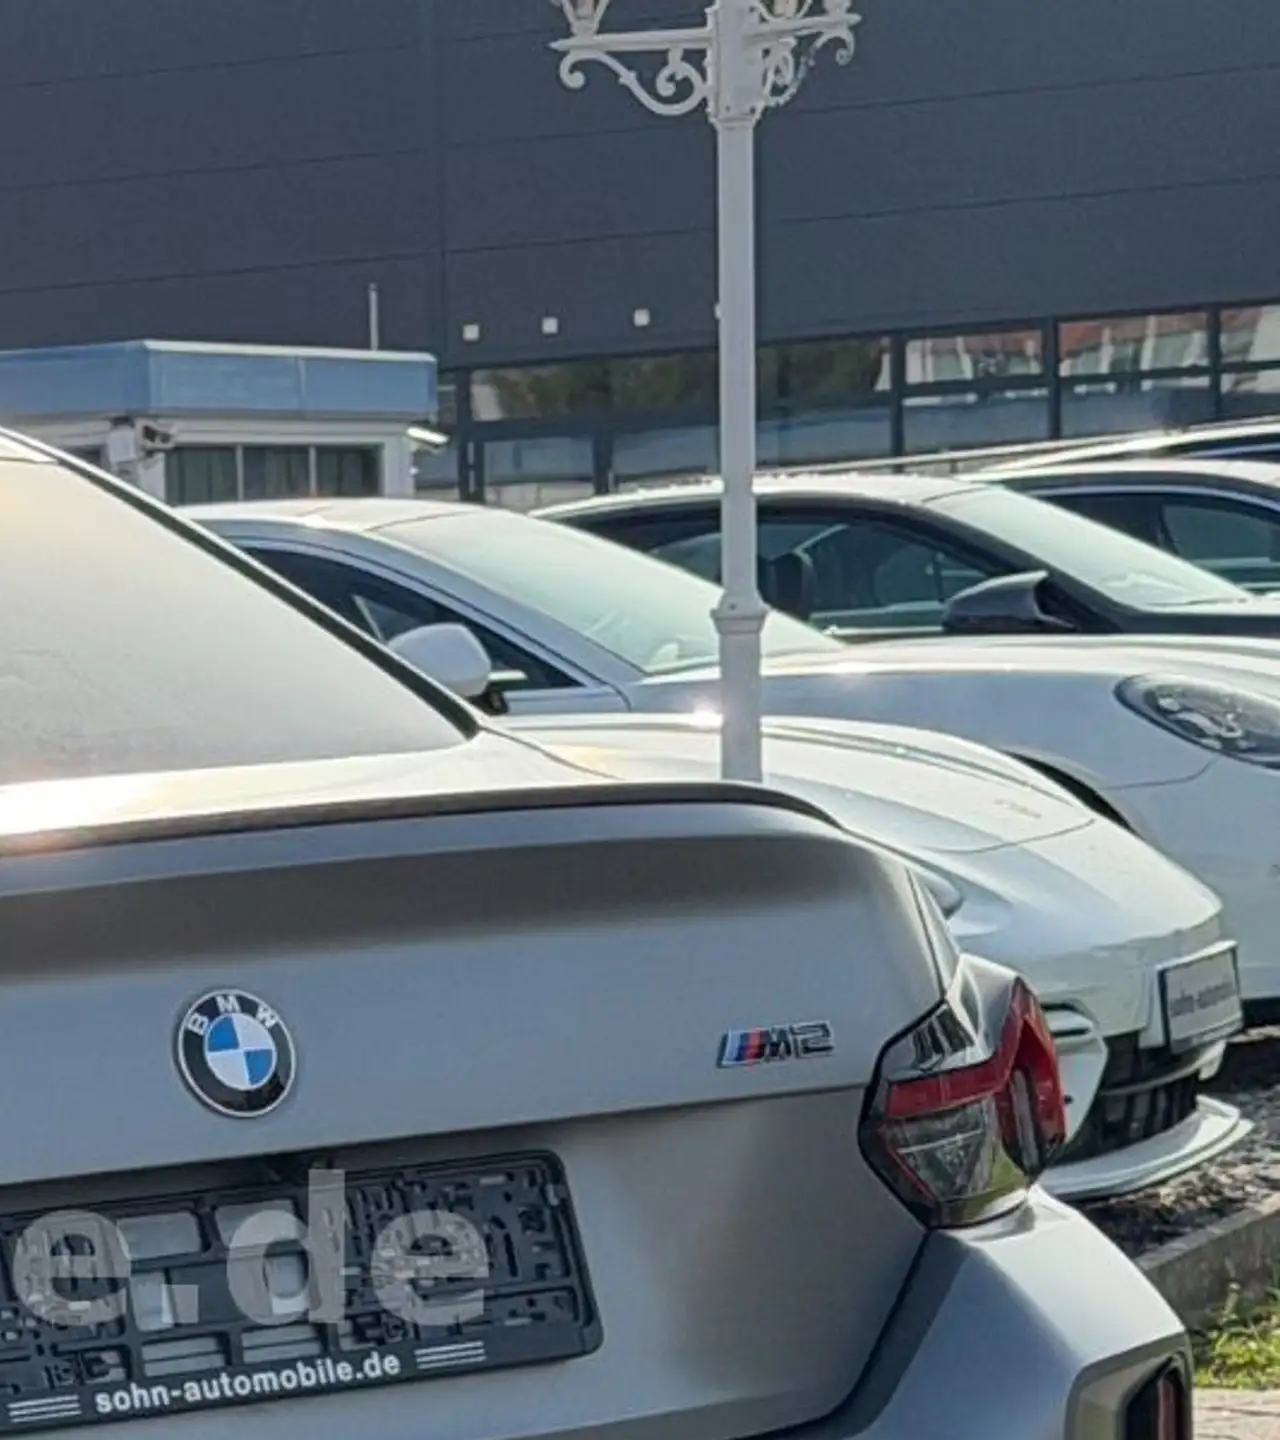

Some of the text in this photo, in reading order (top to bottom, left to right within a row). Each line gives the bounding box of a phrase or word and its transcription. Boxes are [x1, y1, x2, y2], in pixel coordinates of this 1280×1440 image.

[188, 996, 277, 1036] BMW
[760, 1020, 837, 1063] M2
[94, 1351, 402, 1414] sohn-automobile.de
